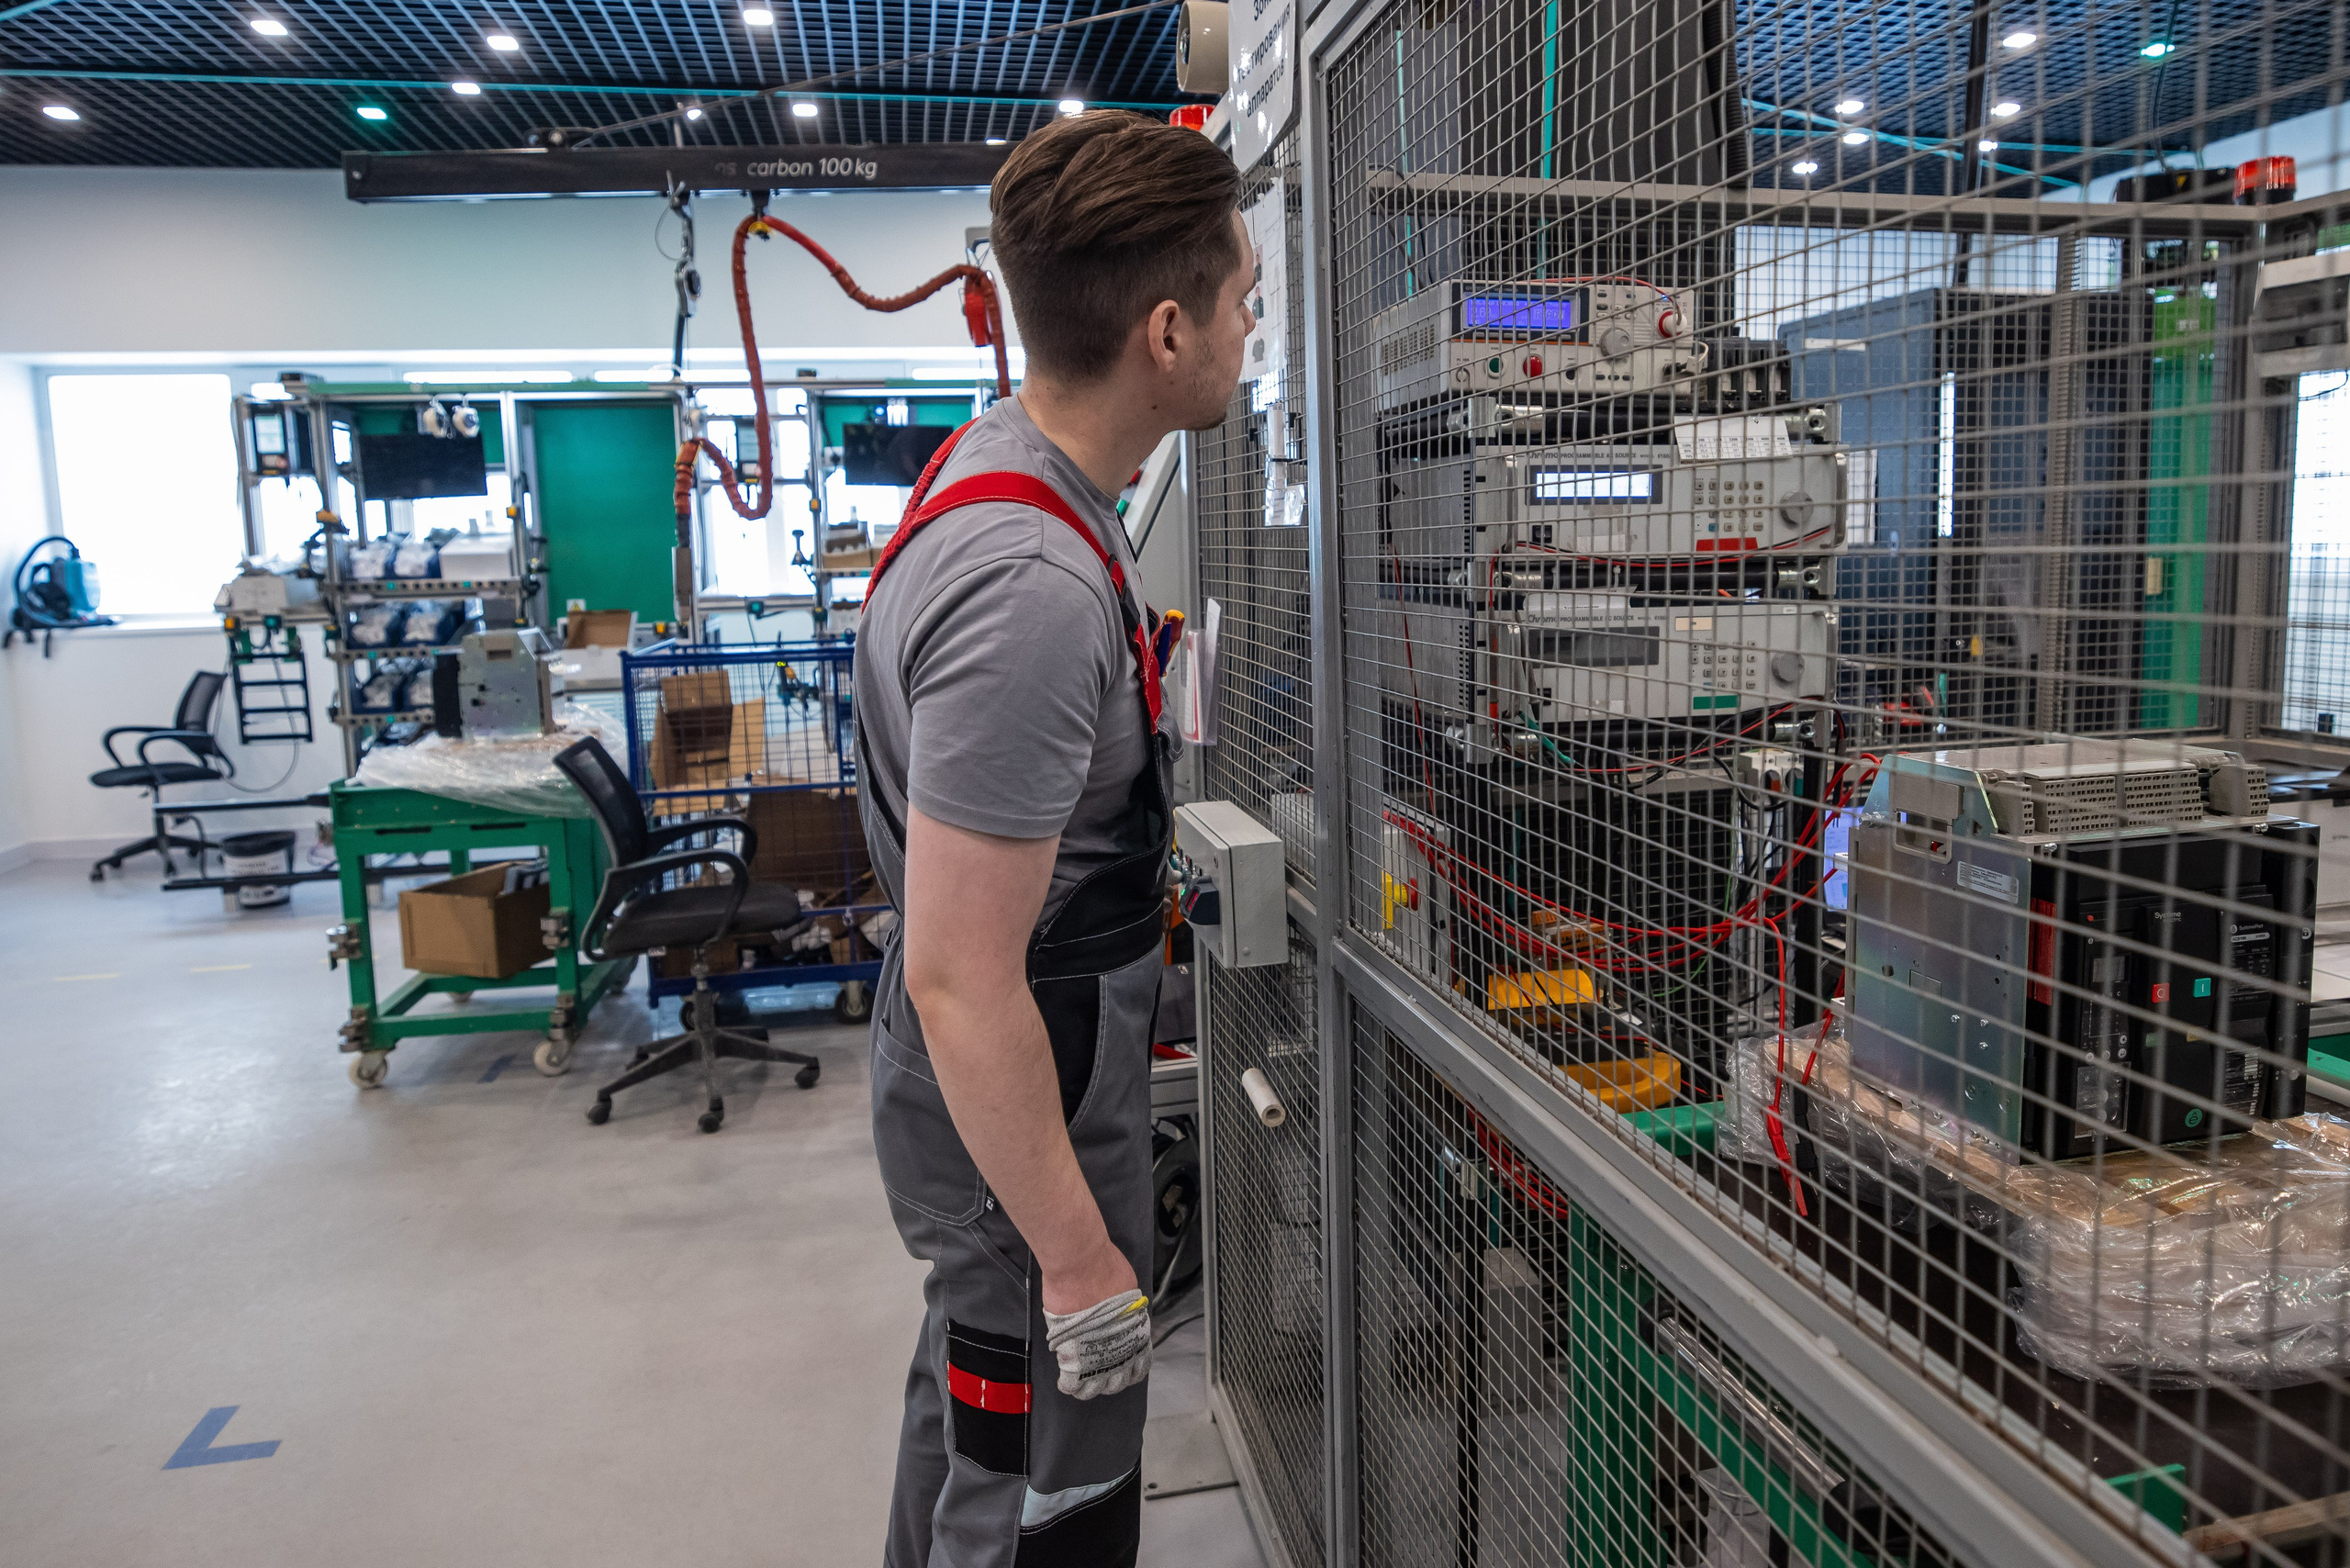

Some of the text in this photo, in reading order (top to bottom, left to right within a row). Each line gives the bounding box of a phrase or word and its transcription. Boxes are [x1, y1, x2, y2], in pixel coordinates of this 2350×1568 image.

[1253, 0, 1271, 21] Зон
[1247, 58, 1284, 118] аппаратов
[746, 158, 814, 177] carbon
